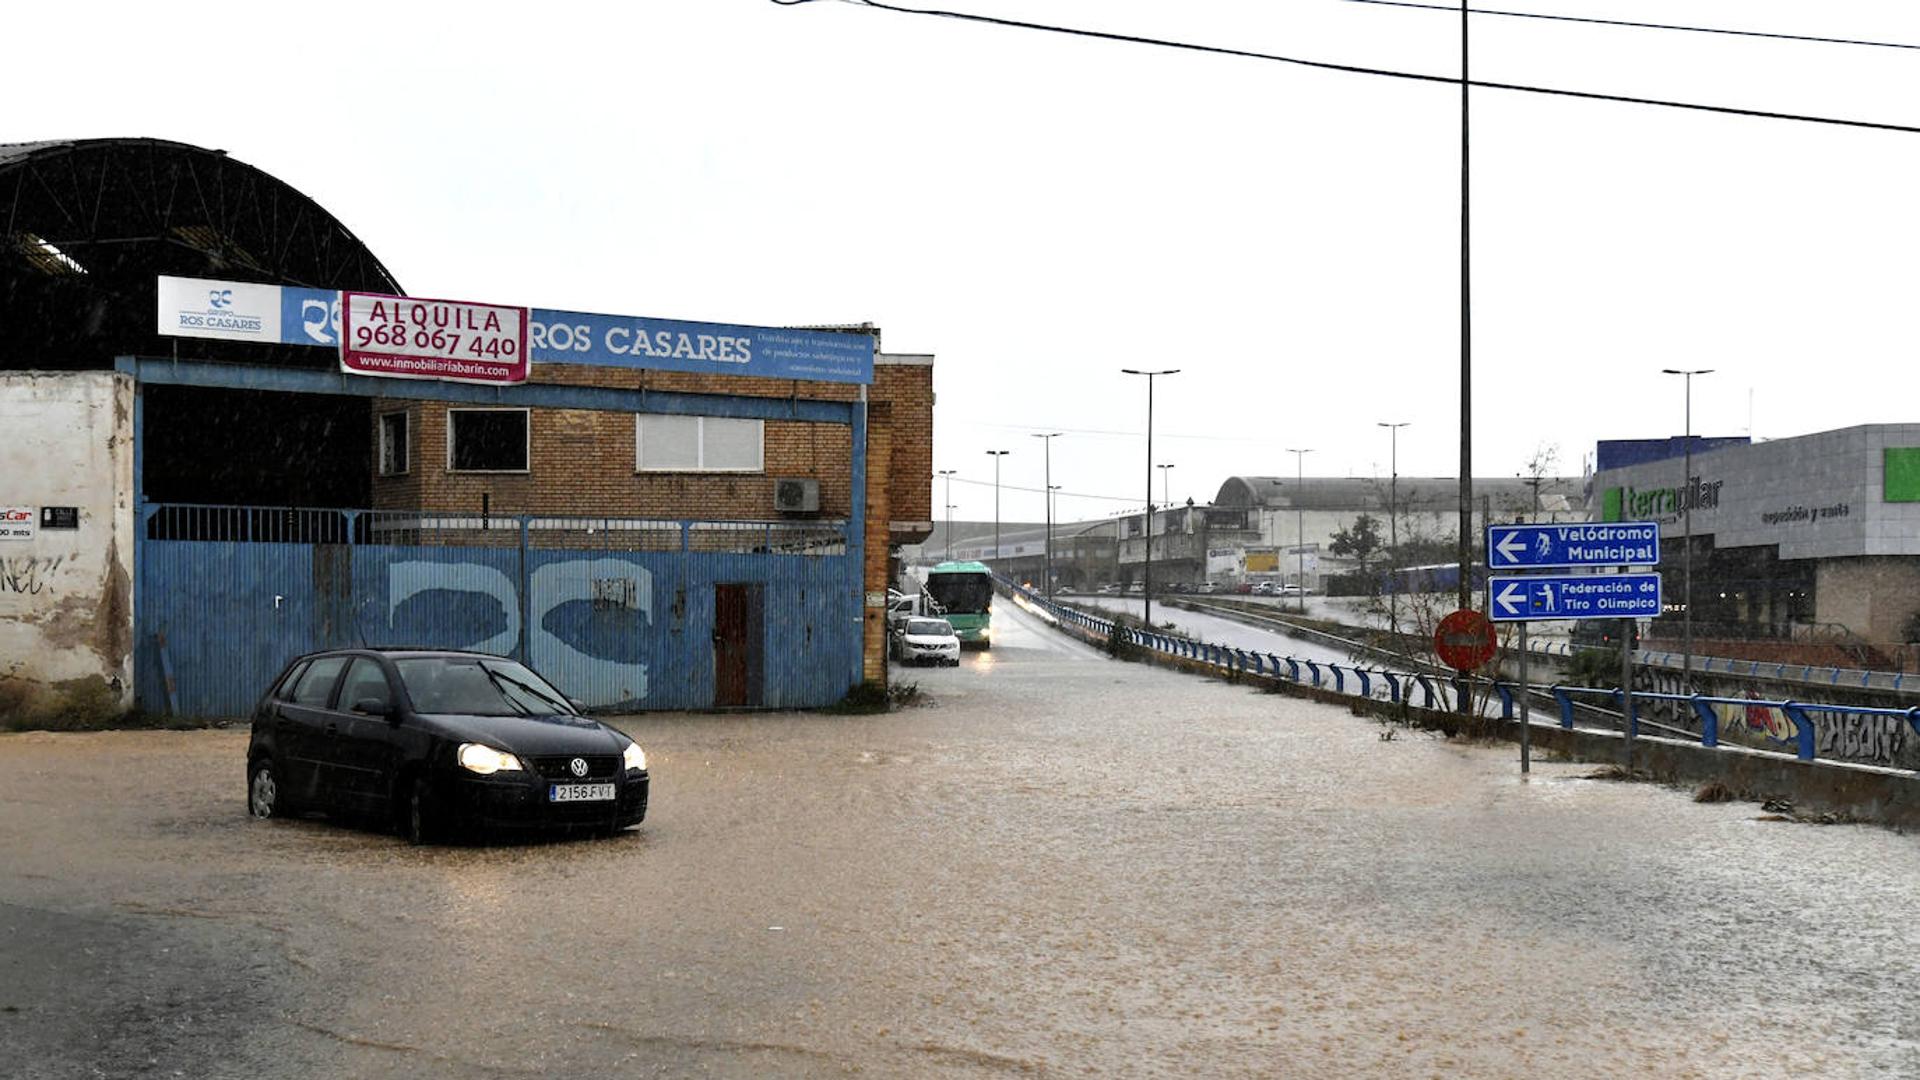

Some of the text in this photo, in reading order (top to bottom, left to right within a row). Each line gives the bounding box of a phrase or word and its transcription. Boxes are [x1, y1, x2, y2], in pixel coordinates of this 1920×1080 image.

[180, 315, 261, 330] ROS CASARES
[370, 301, 501, 332] ALQUILA
[357, 324, 515, 358] 968 067 440
[531, 322, 752, 364] ROS CASARES
[360, 356, 509, 377] www.inmobiliariabarin.com
[1811, 508, 1818, 523] y
[1558, 527, 1653, 542] Velódromo
[1568, 545, 1653, 562] Municipal
[1562, 581, 1656, 594] Federación de
[1565, 599, 1590, 610] Tiro
[560, 786, 588, 799] 2156
